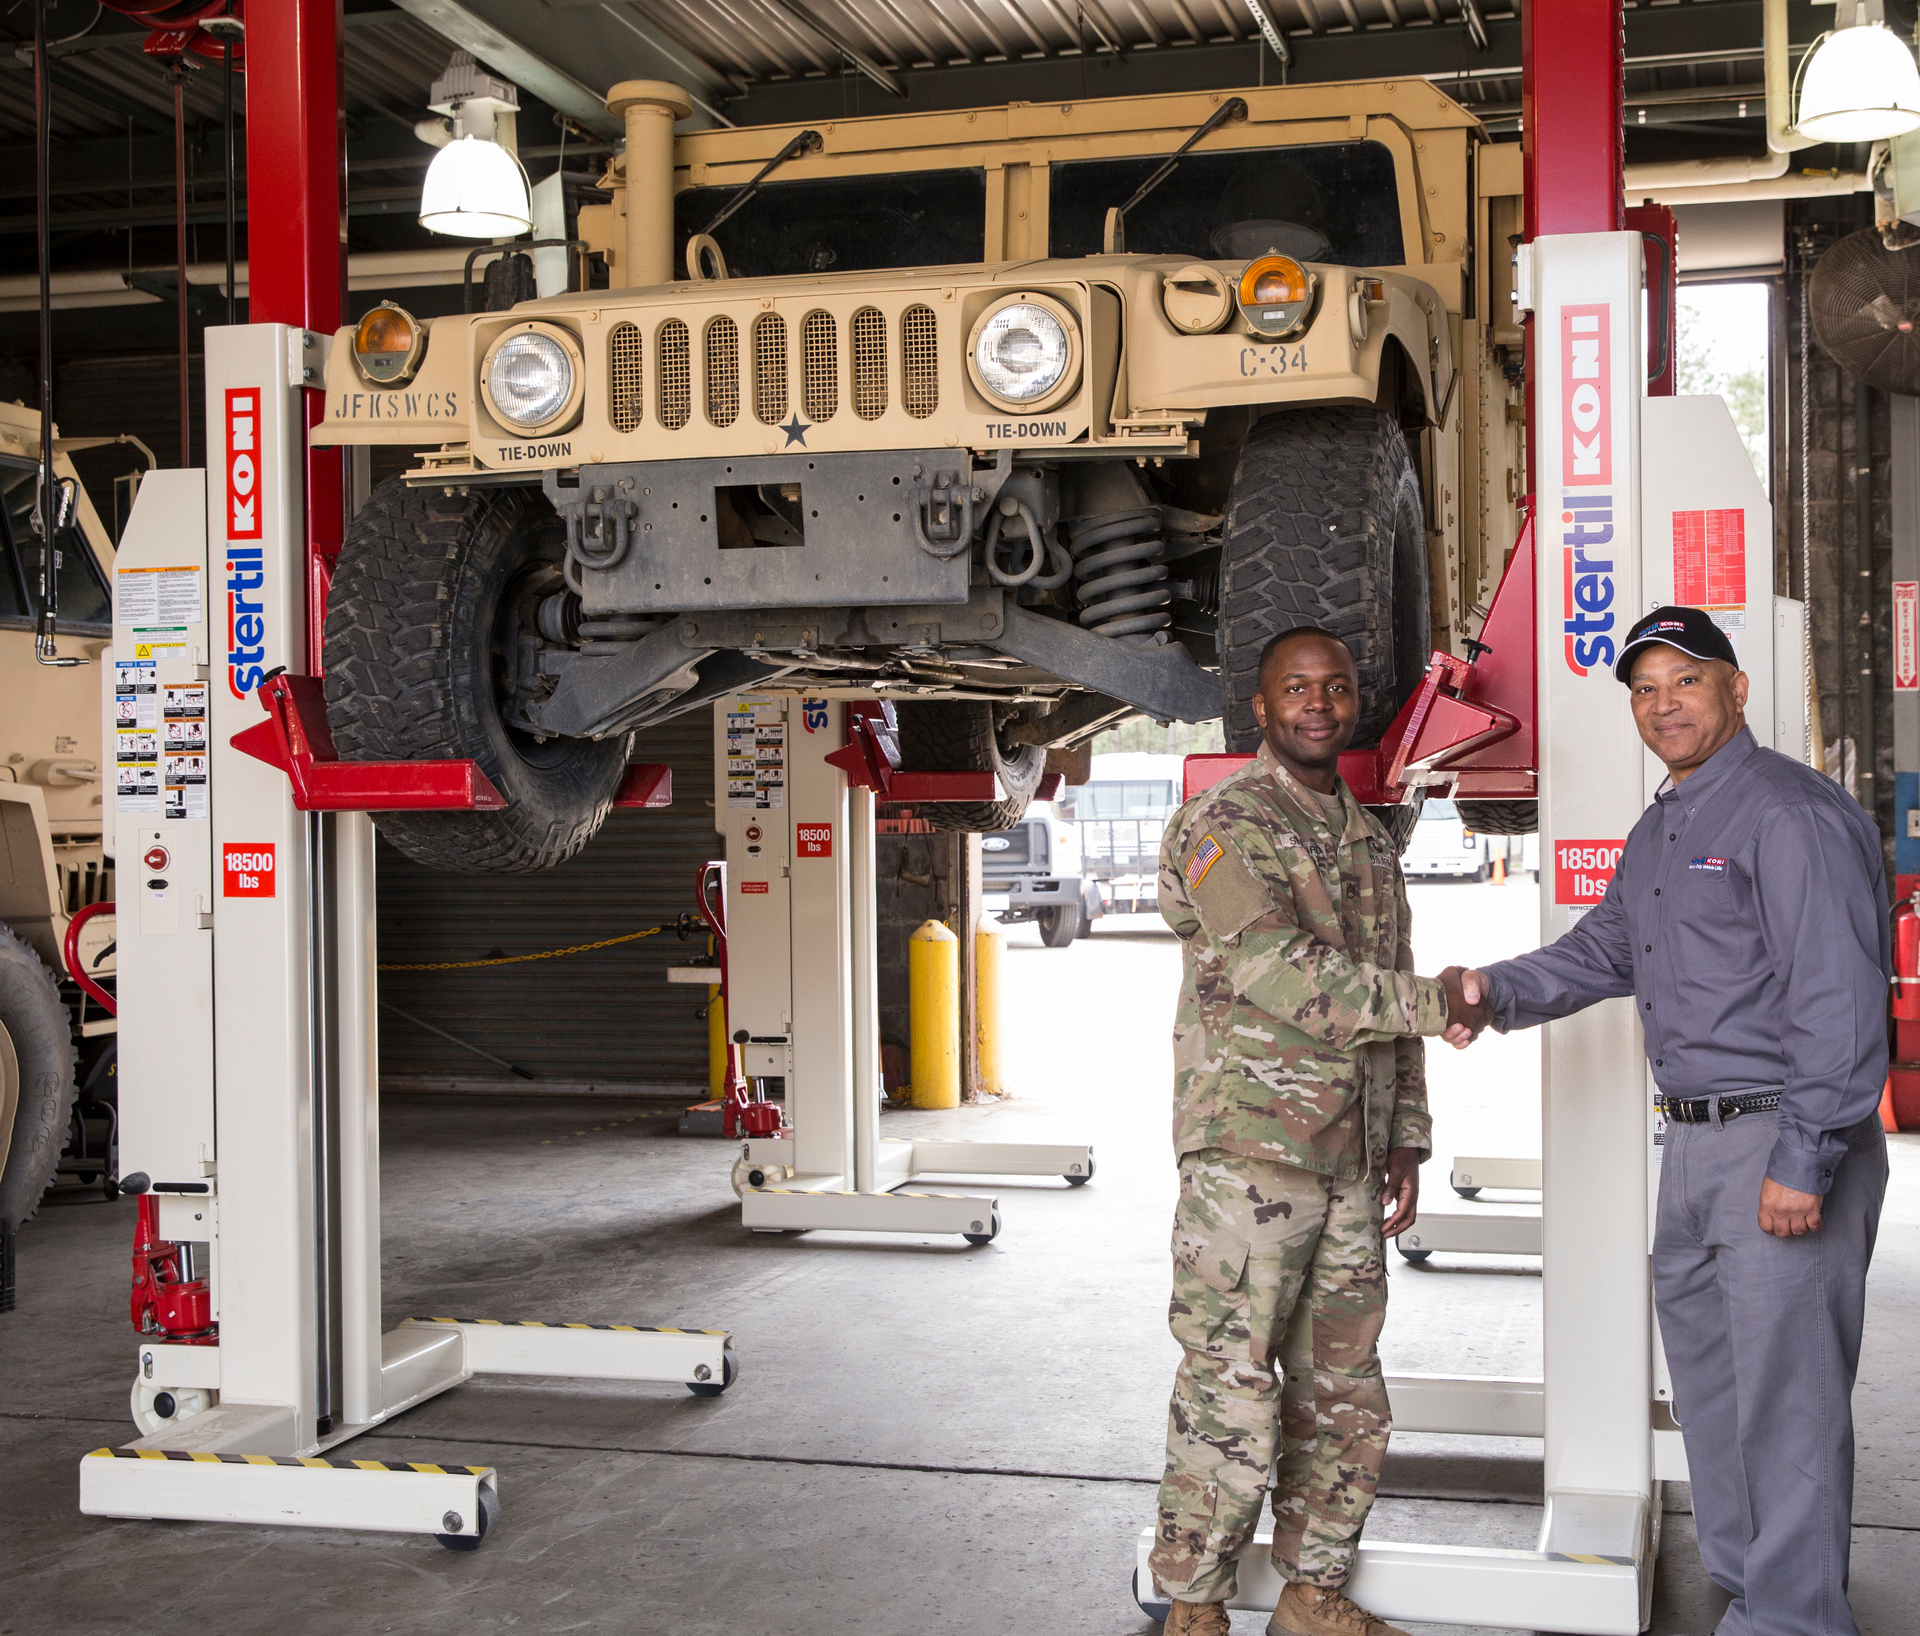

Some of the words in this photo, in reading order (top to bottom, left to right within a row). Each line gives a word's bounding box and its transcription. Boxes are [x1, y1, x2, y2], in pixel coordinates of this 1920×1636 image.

[1240, 344, 1308, 377] C-34
[335, 392, 457, 418] JFKSWCS
[1571, 315, 1600, 476] KONI
[986, 421, 1066, 438] TIE-DOWN
[498, 442, 572, 461] TIE-DOWN
[232, 397, 255, 531] KONI
[1563, 494, 1615, 677] stertil
[1895, 589, 1915, 599] FIRE
[227, 548, 264, 700] stertil
[1902, 601, 1910, 681] EXTINGUISHER
[799, 829, 830, 841] 18500
[807, 842, 821, 851] lbs
[225, 853, 273, 871] 18500
[1557, 847, 1624, 870] 18500
[239, 873, 259, 888] lbs
[1574, 874, 1607, 896] lbs
